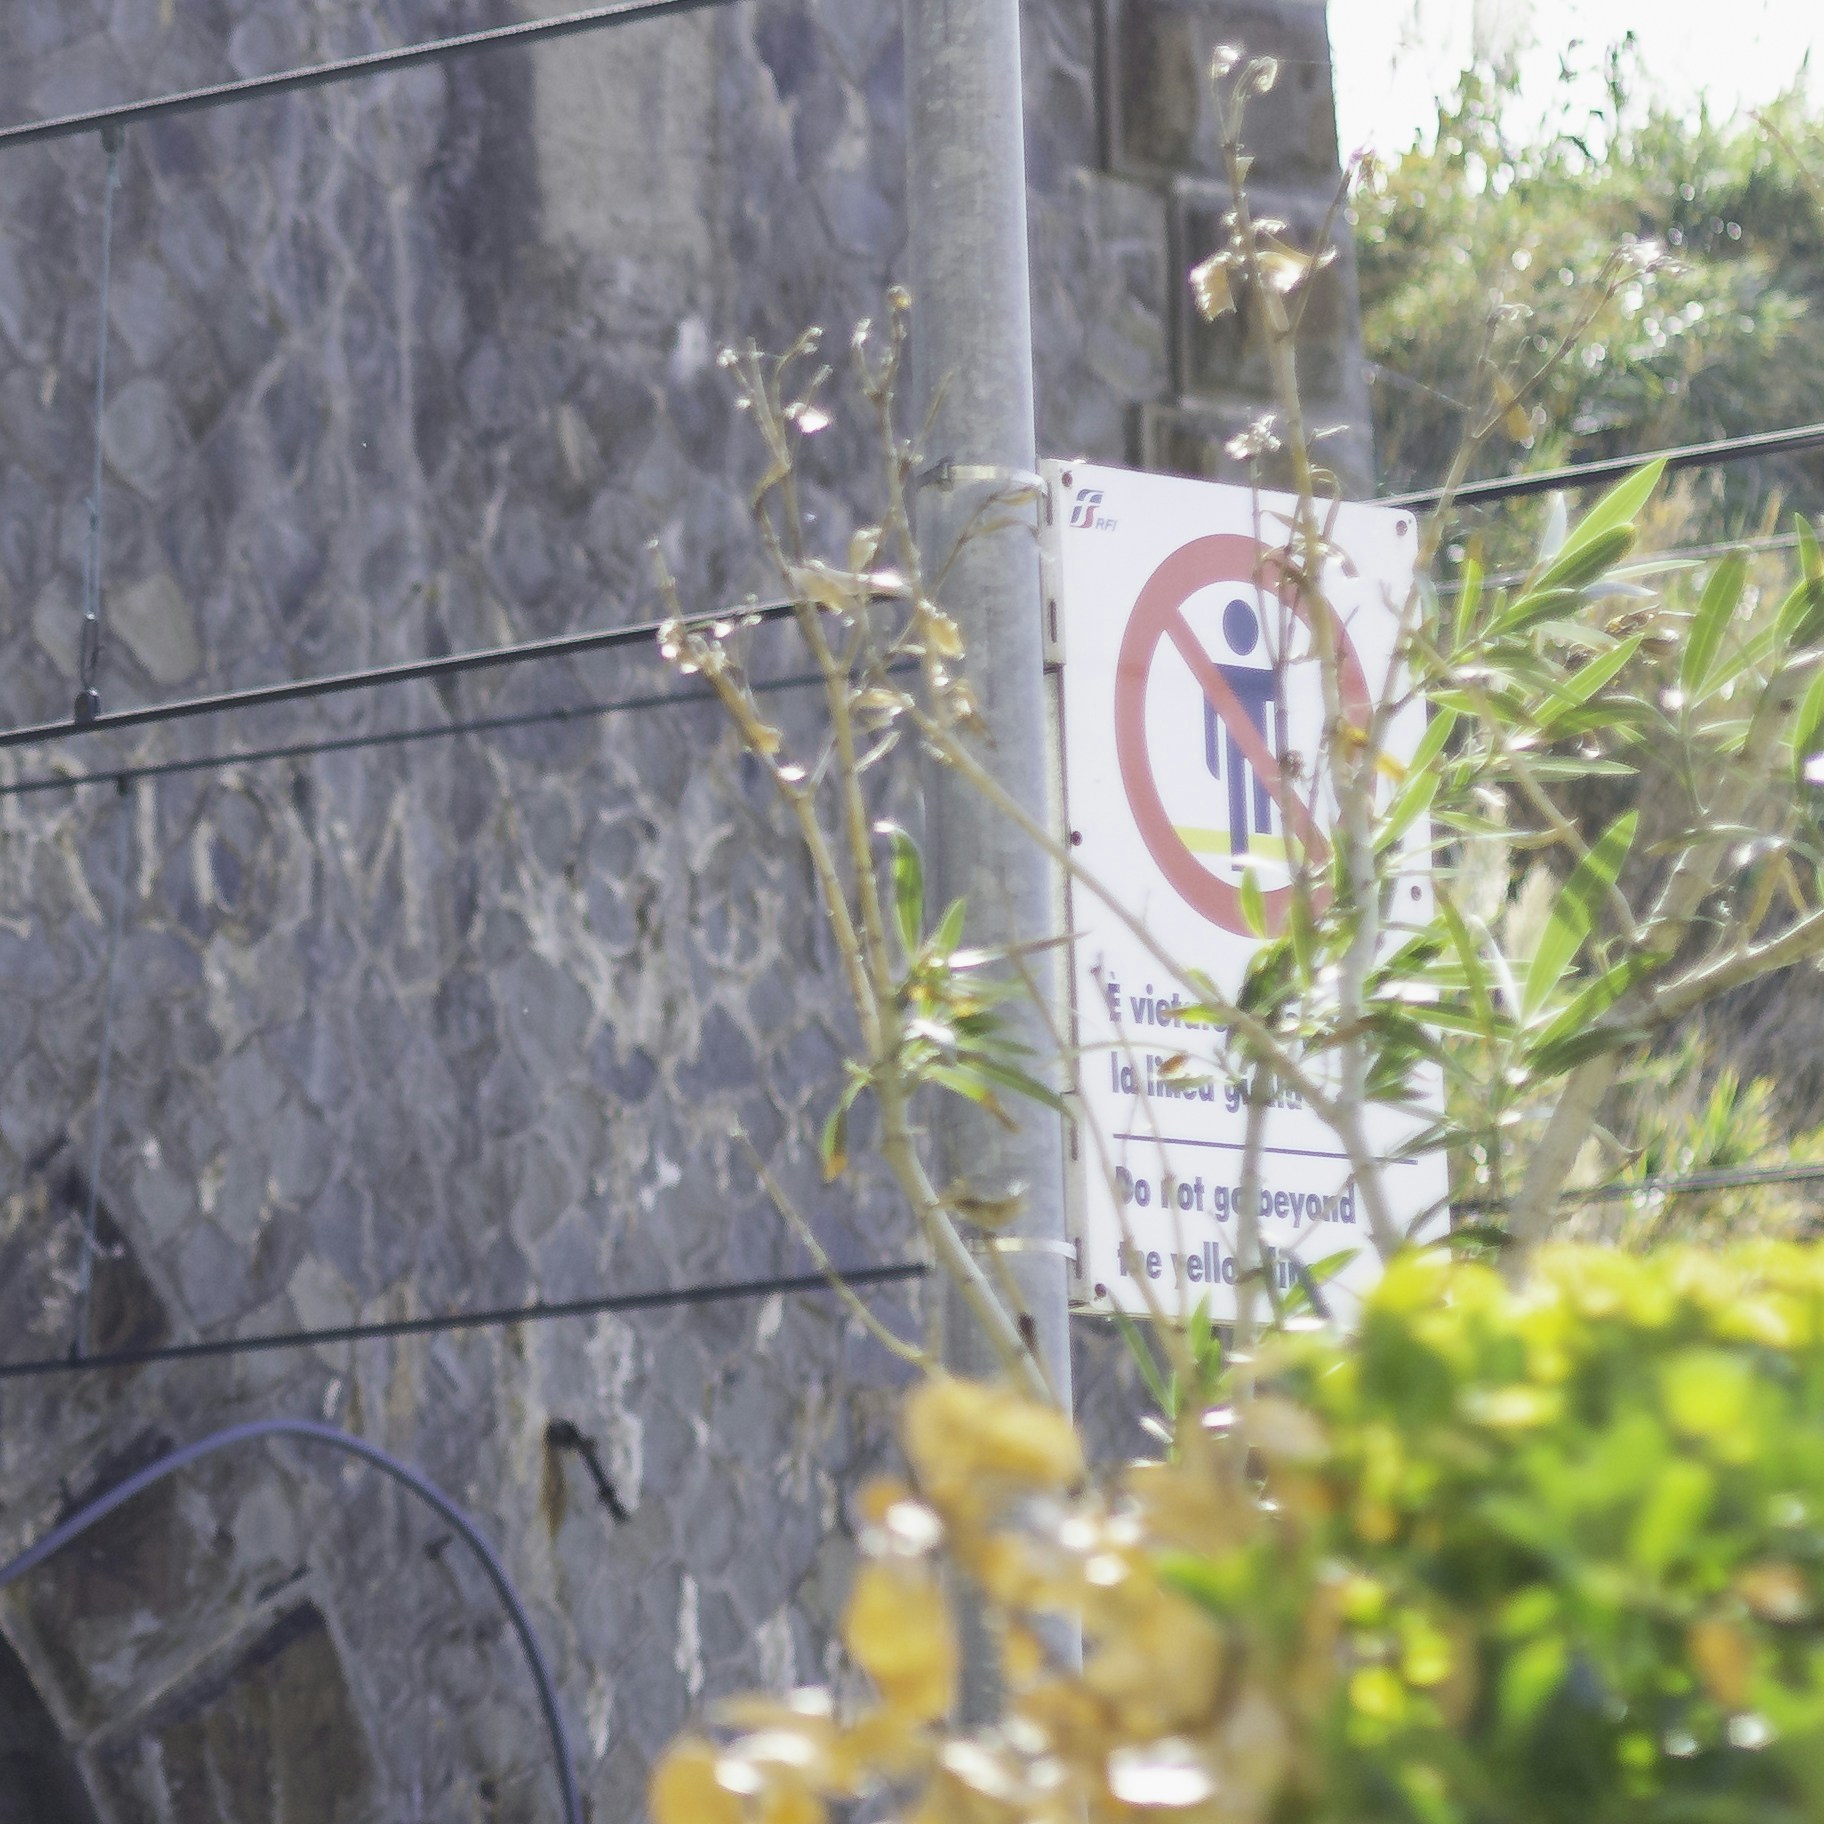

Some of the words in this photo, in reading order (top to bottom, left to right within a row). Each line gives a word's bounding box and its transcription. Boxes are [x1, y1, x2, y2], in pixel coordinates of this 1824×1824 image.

[1095, 518, 1118, 532] RFI
[1111, 1051, 1140, 1095] la
[1116, 1166, 1151, 1208] Do
